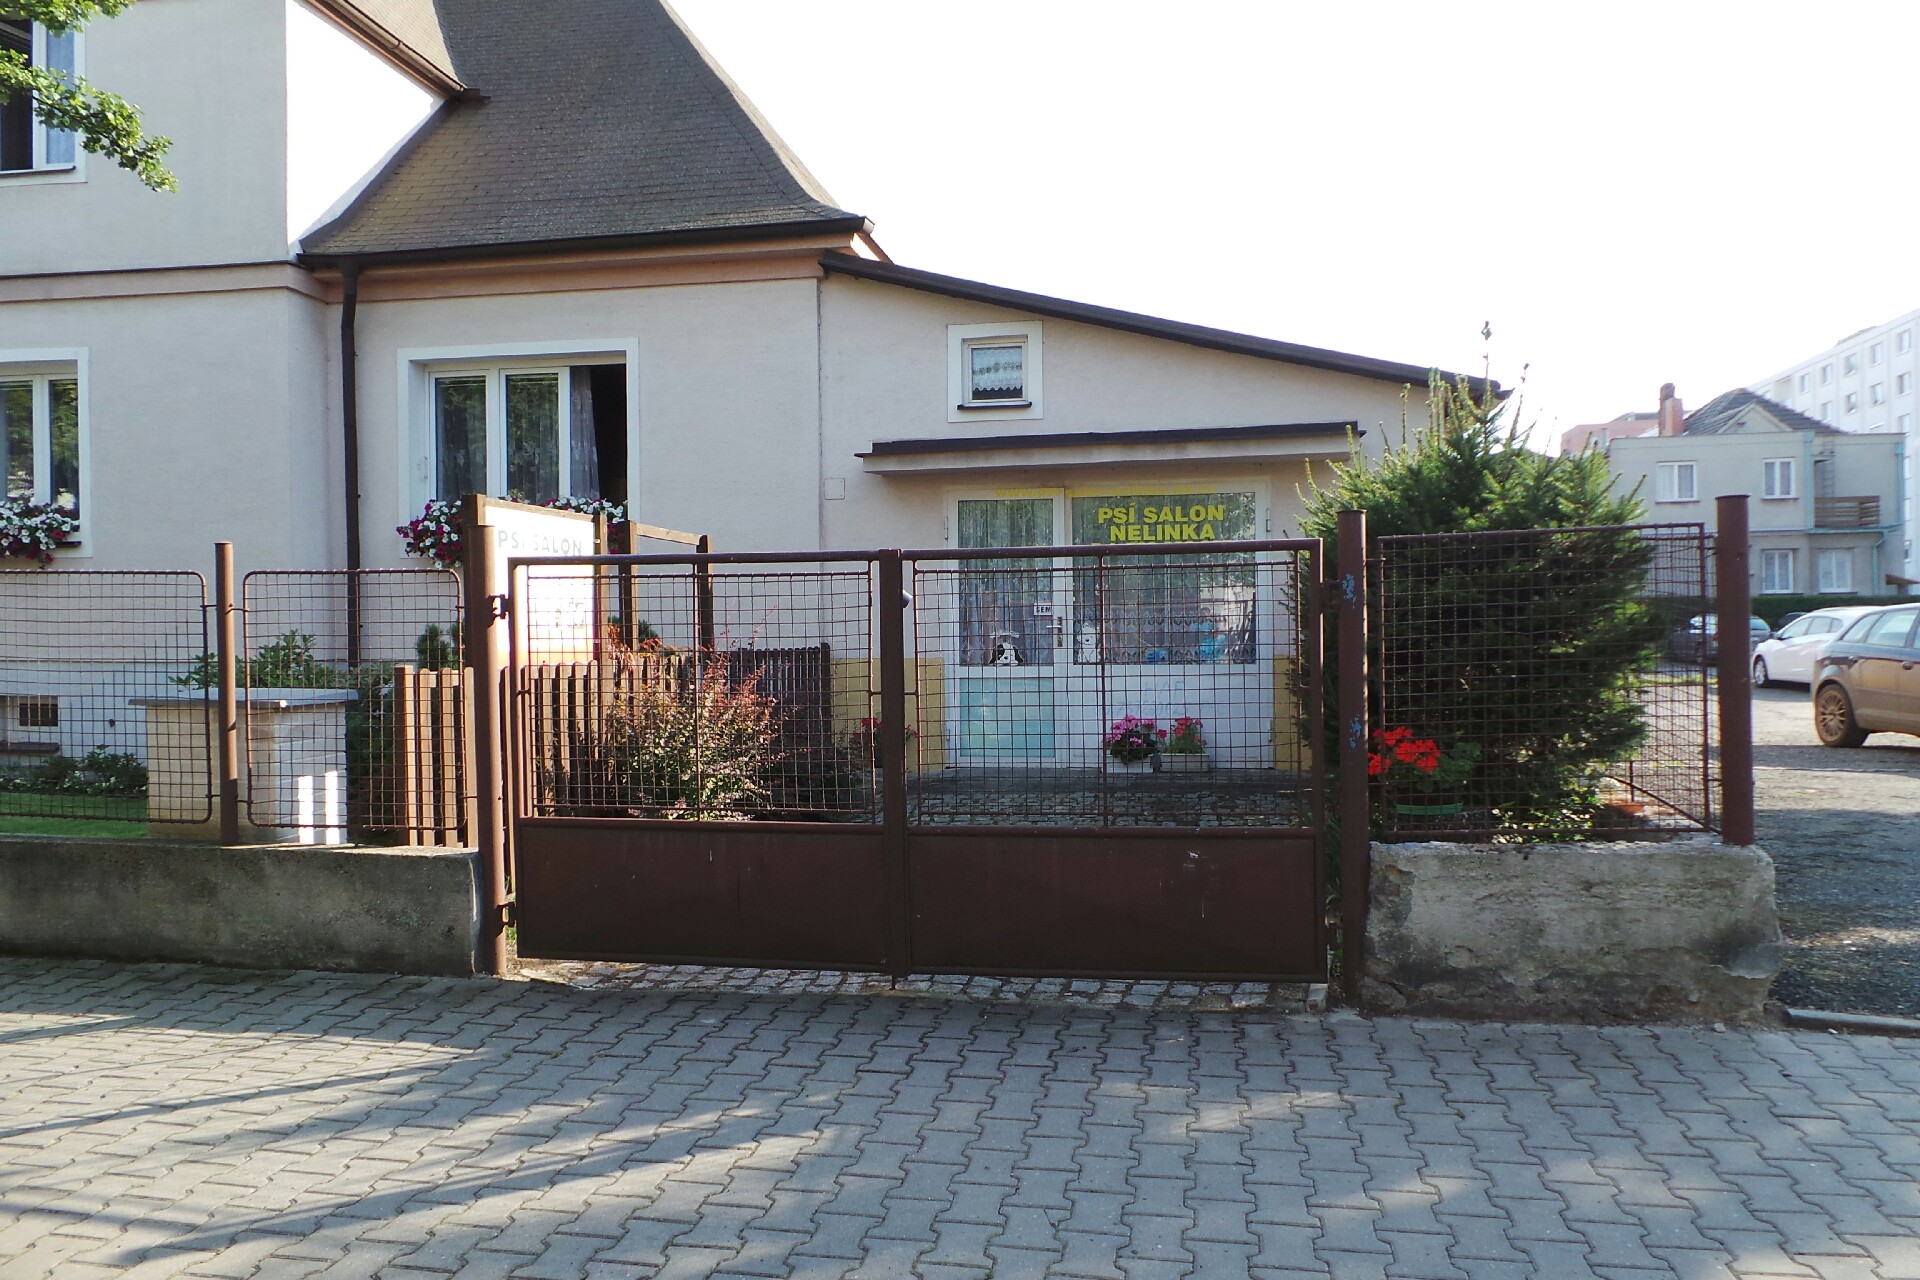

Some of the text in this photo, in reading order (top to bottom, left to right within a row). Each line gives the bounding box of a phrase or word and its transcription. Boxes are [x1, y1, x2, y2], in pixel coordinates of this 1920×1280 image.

[1098, 503, 1224, 524] PSÍ SALON
[1110, 524, 1216, 542] NELINKA
[534, 534, 582, 556] SALON
